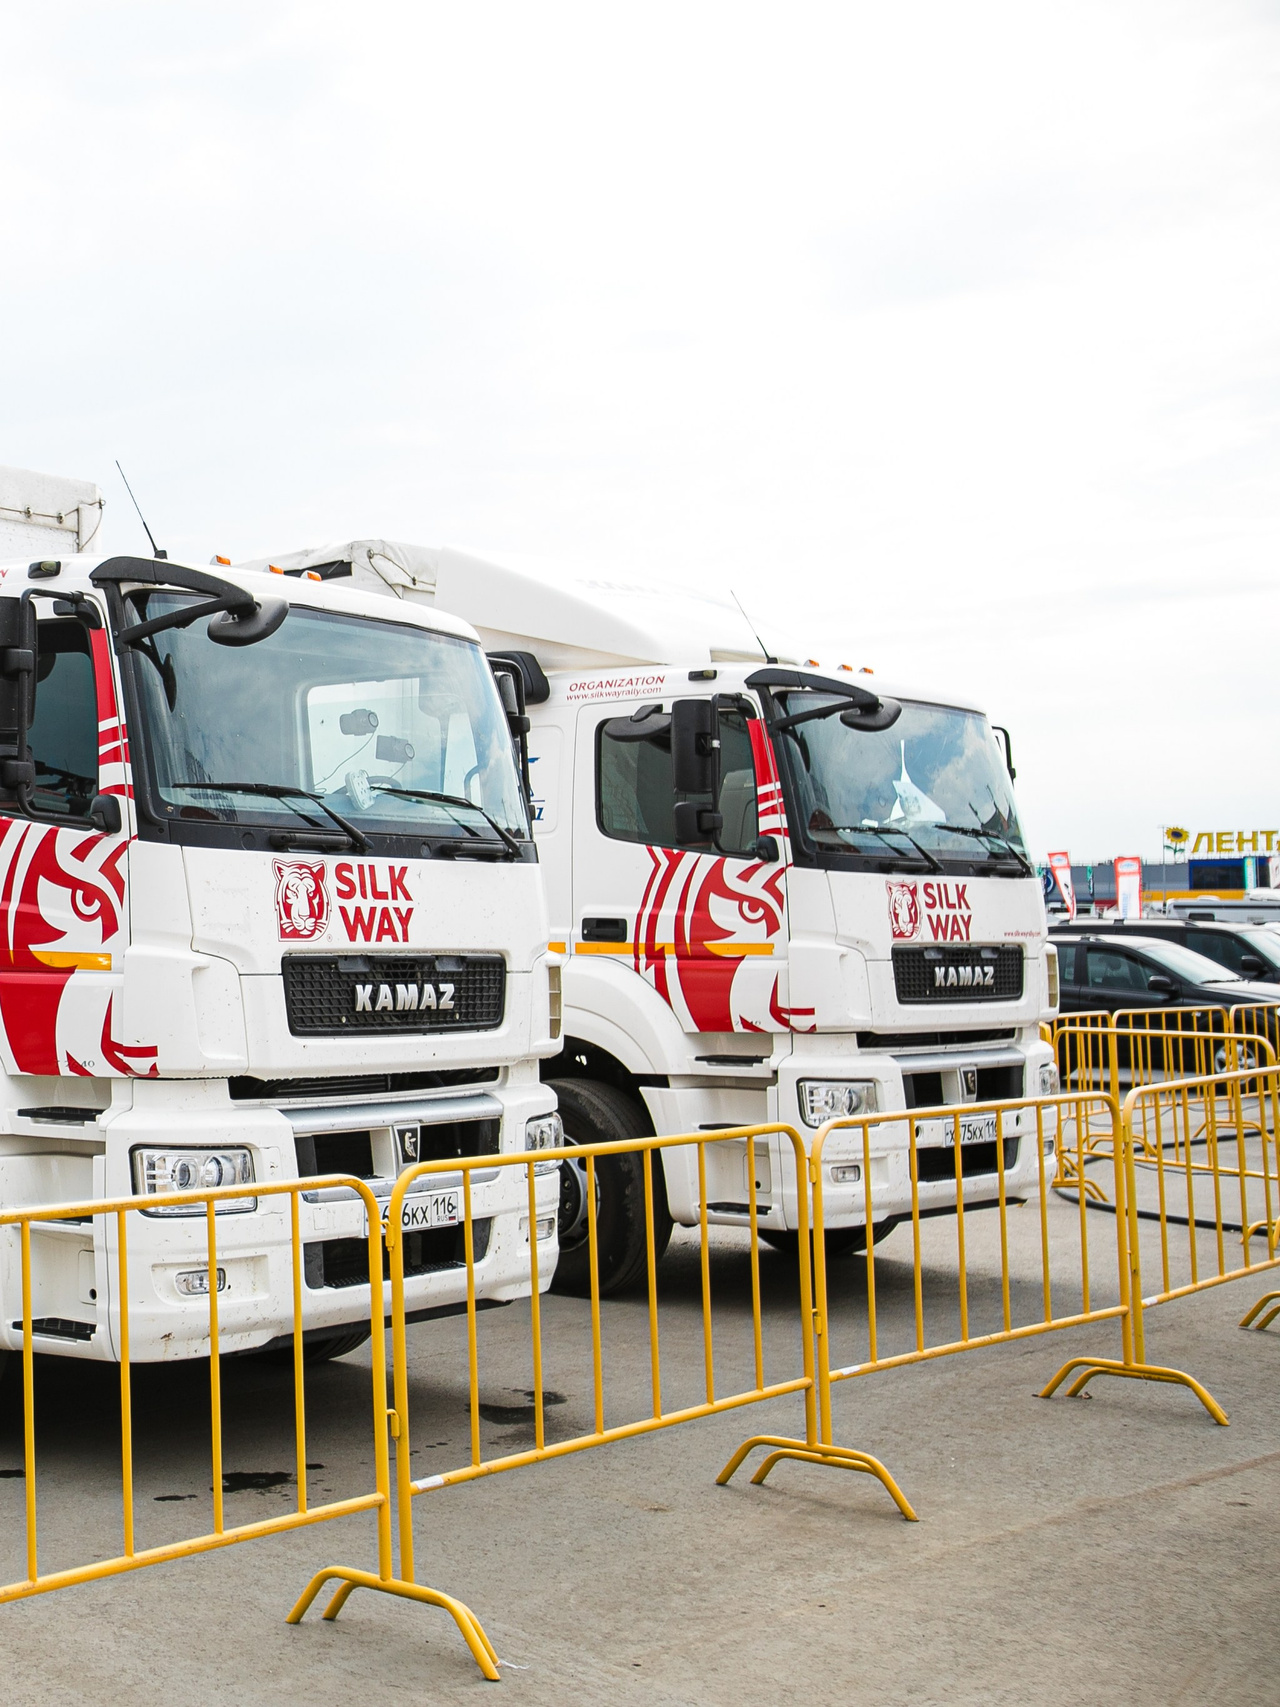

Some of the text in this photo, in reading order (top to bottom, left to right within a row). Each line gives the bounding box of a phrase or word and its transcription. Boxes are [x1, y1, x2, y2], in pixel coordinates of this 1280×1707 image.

[566, 686, 662, 701] www.silkwayrally.com
[569, 675, 666, 692] ORGANIZATION
[1191, 830, 1280, 854] ЛЕНТ
[334, 862, 414, 902] SILK
[922, 881, 971, 911] SILK
[338, 905, 415, 943] WAY
[927, 914, 973, 942] WAY
[934, 965, 995, 987] KAMAZ
[355, 983, 455, 1012] KAMAZ
[949, 1123, 984, 1143] X75KX
[432, 1196, 454, 1216] 116
